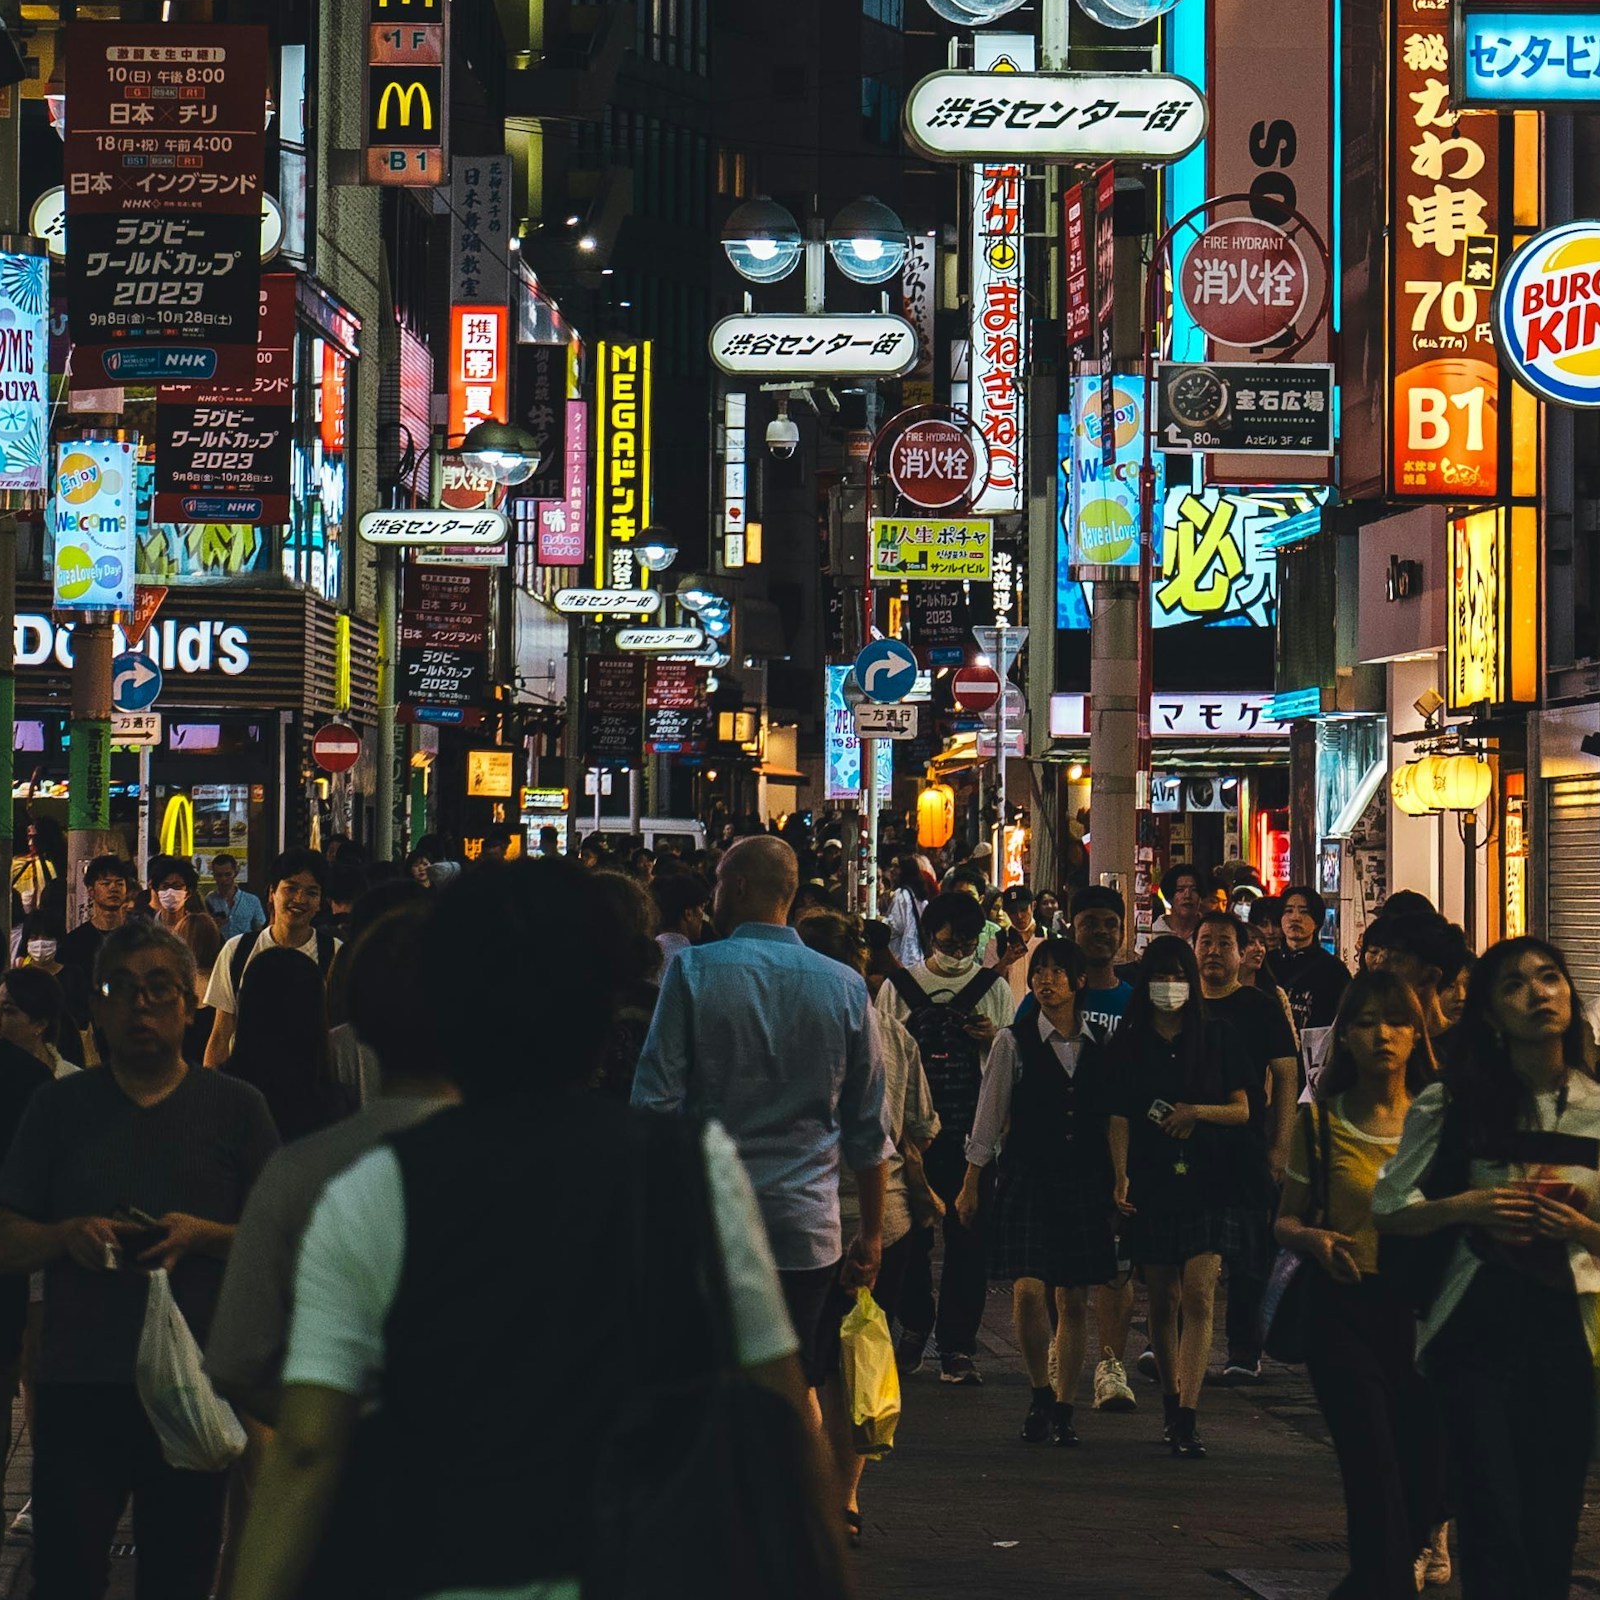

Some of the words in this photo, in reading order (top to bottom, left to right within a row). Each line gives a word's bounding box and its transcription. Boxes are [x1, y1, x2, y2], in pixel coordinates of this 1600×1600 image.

[109, 102, 155, 126] 日本
[178, 103, 218, 125] チリ
[926, 97, 1194, 133] 渋谷センター街
[70, 172, 113, 195] 日本
[136, 173, 258, 196] イングランド
[115, 218, 206, 245] ラグビー
[1203, 236, 1228, 249] FIRE
[1232, 237, 1285, 250] HYDRANT
[85, 249, 242, 278] ワールドカップ
[1193, 258, 1296, 306] 消火栓
[113, 281, 205, 306] 2023
[721, 332, 905, 357] 渋谷センター街
[164, 353, 207, 367] NHK
[1235, 389, 1325, 413] 宝石広場
[192, 407, 255, 428] ラグビー
[1407, 387, 1485, 452] B1
[171, 429, 280, 449] ワールドカップ
[611, 345, 637, 542] MEGAドンキ
[906, 432, 924, 441] FIRE
[925, 432, 961, 442] HYDRANT
[1193, 431, 1221, 446] 80m
[190, 452, 255, 469] 2023
[899, 448, 970, 480] 消火栓
[59, 465, 98, 496] Enjoy
[226, 500, 256, 513] NHK
[56, 511, 127, 533] Welcome
[367, 518, 496, 537] 渋谷センター街
[896, 526, 934, 545] 人生
[936, 527, 988, 546] ポチャ
[542, 545, 582, 557] Taste
[880, 551, 897, 564] 7F
[930, 563, 985, 574] サンルイビル
[925, 610, 953, 625] 2023
[421, 650, 461, 663] ラグビー
[408, 663, 475, 679] ワールドカップ
[419, 678, 460, 691] 2023
[858, 708, 913, 723] 一方通行
